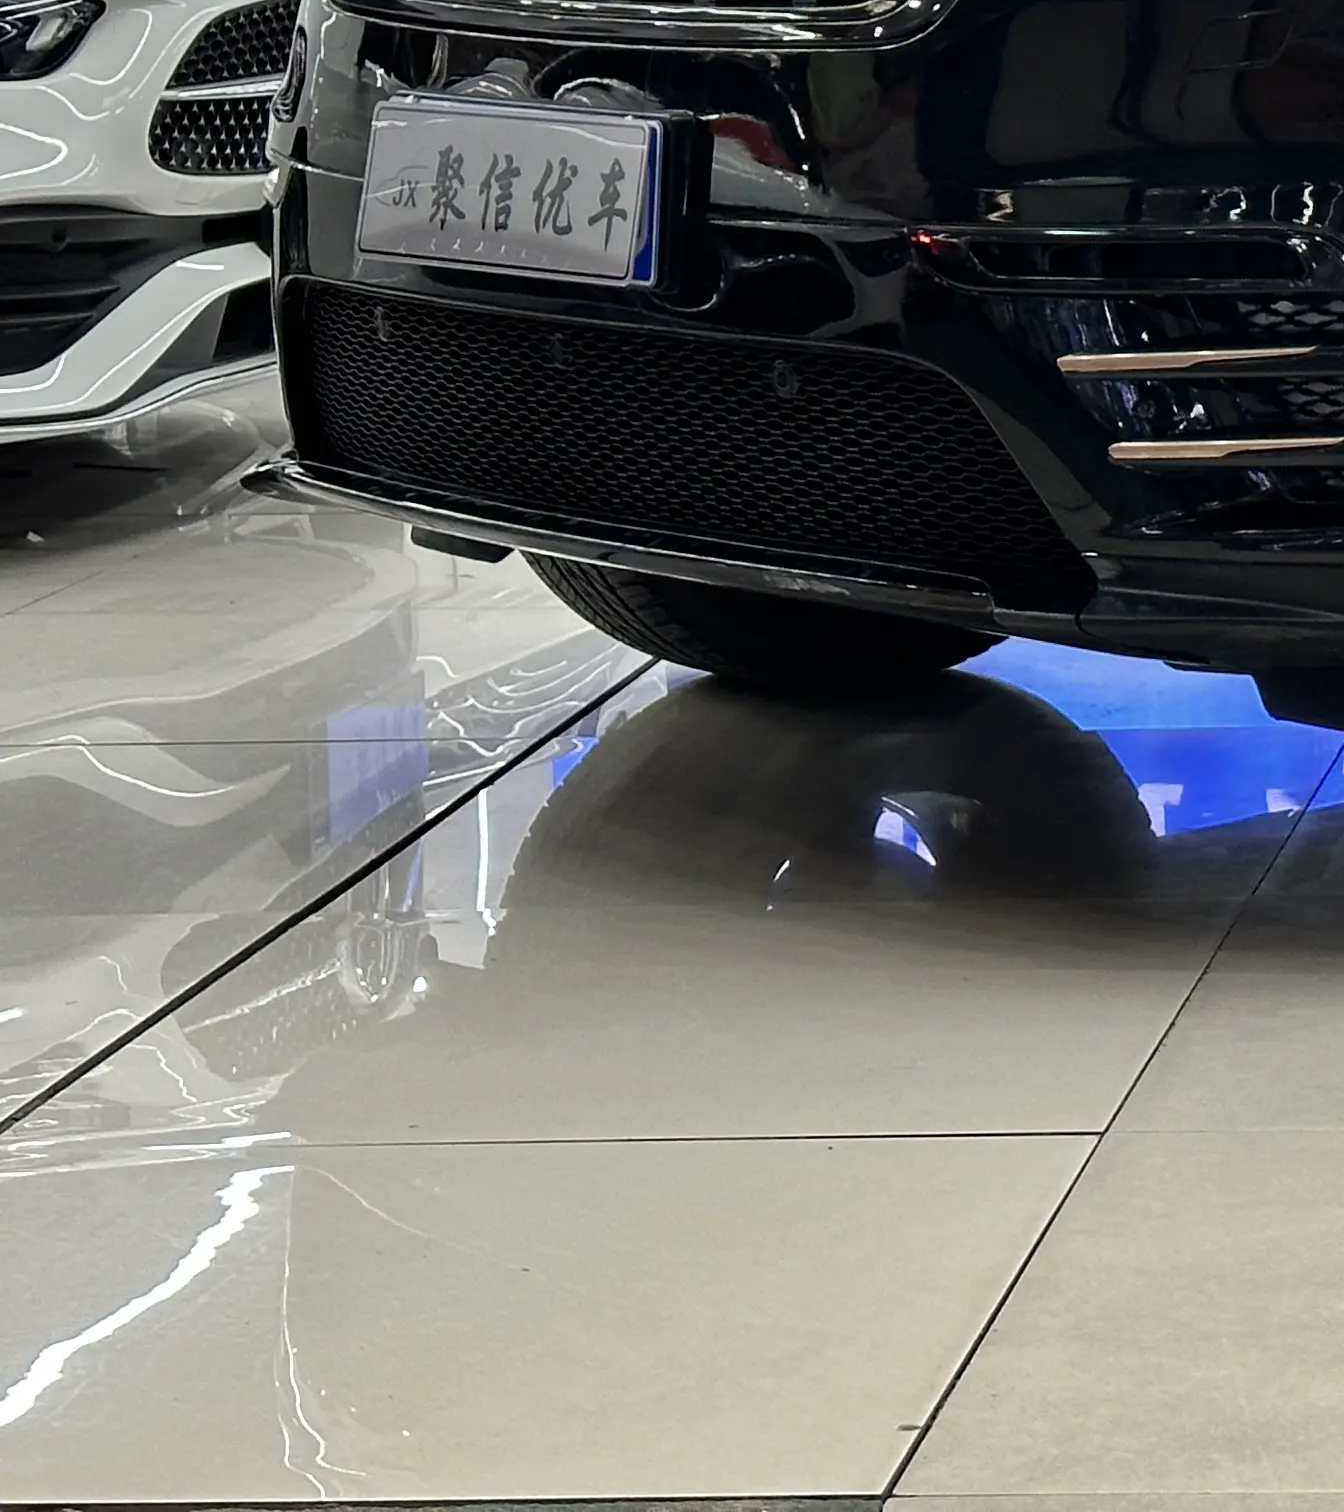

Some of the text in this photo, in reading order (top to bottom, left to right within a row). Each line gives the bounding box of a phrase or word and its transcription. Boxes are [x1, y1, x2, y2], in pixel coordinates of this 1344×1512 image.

[392, 144, 629, 253] JX 聚信优车
